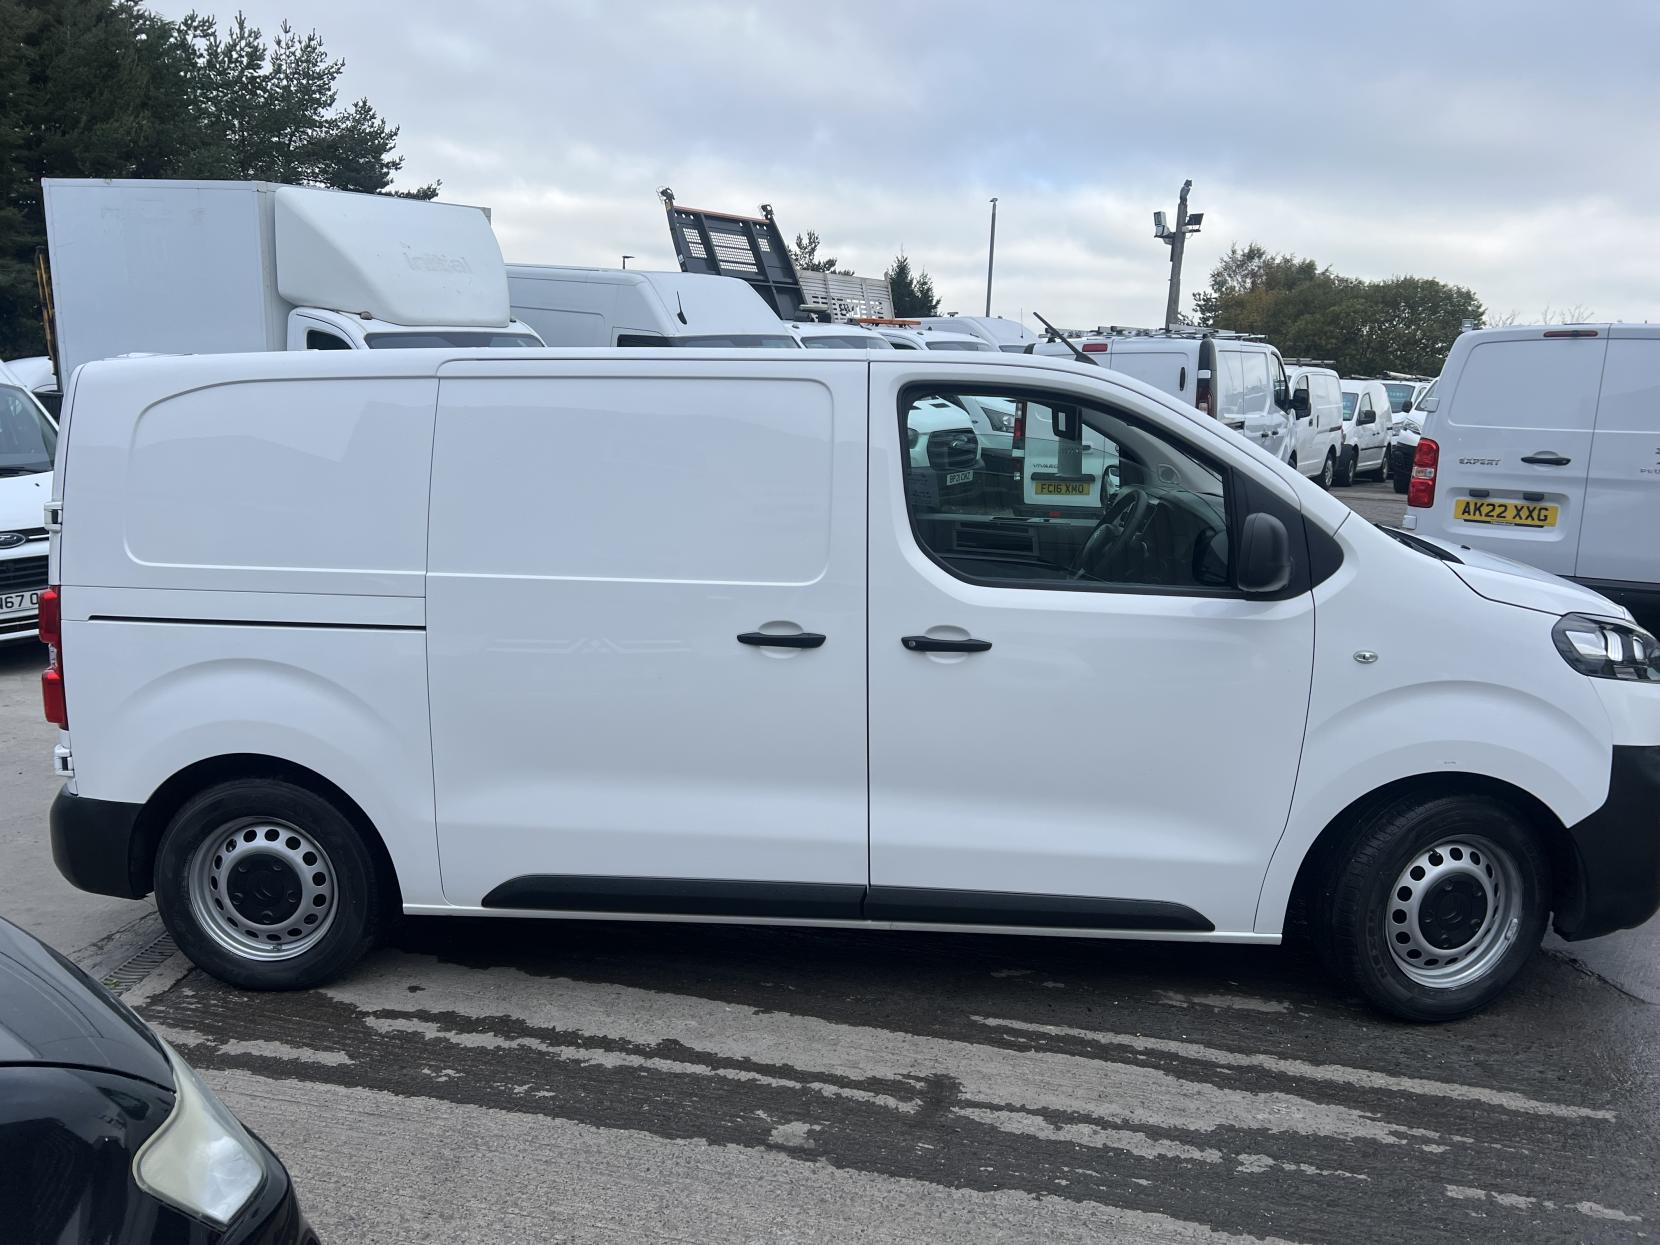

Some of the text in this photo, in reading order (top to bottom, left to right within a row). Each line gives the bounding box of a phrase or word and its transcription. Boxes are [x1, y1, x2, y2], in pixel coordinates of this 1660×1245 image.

[1040, 483, 1062, 494] FC16
[1462, 501, 1550, 522] AK22 XXG
